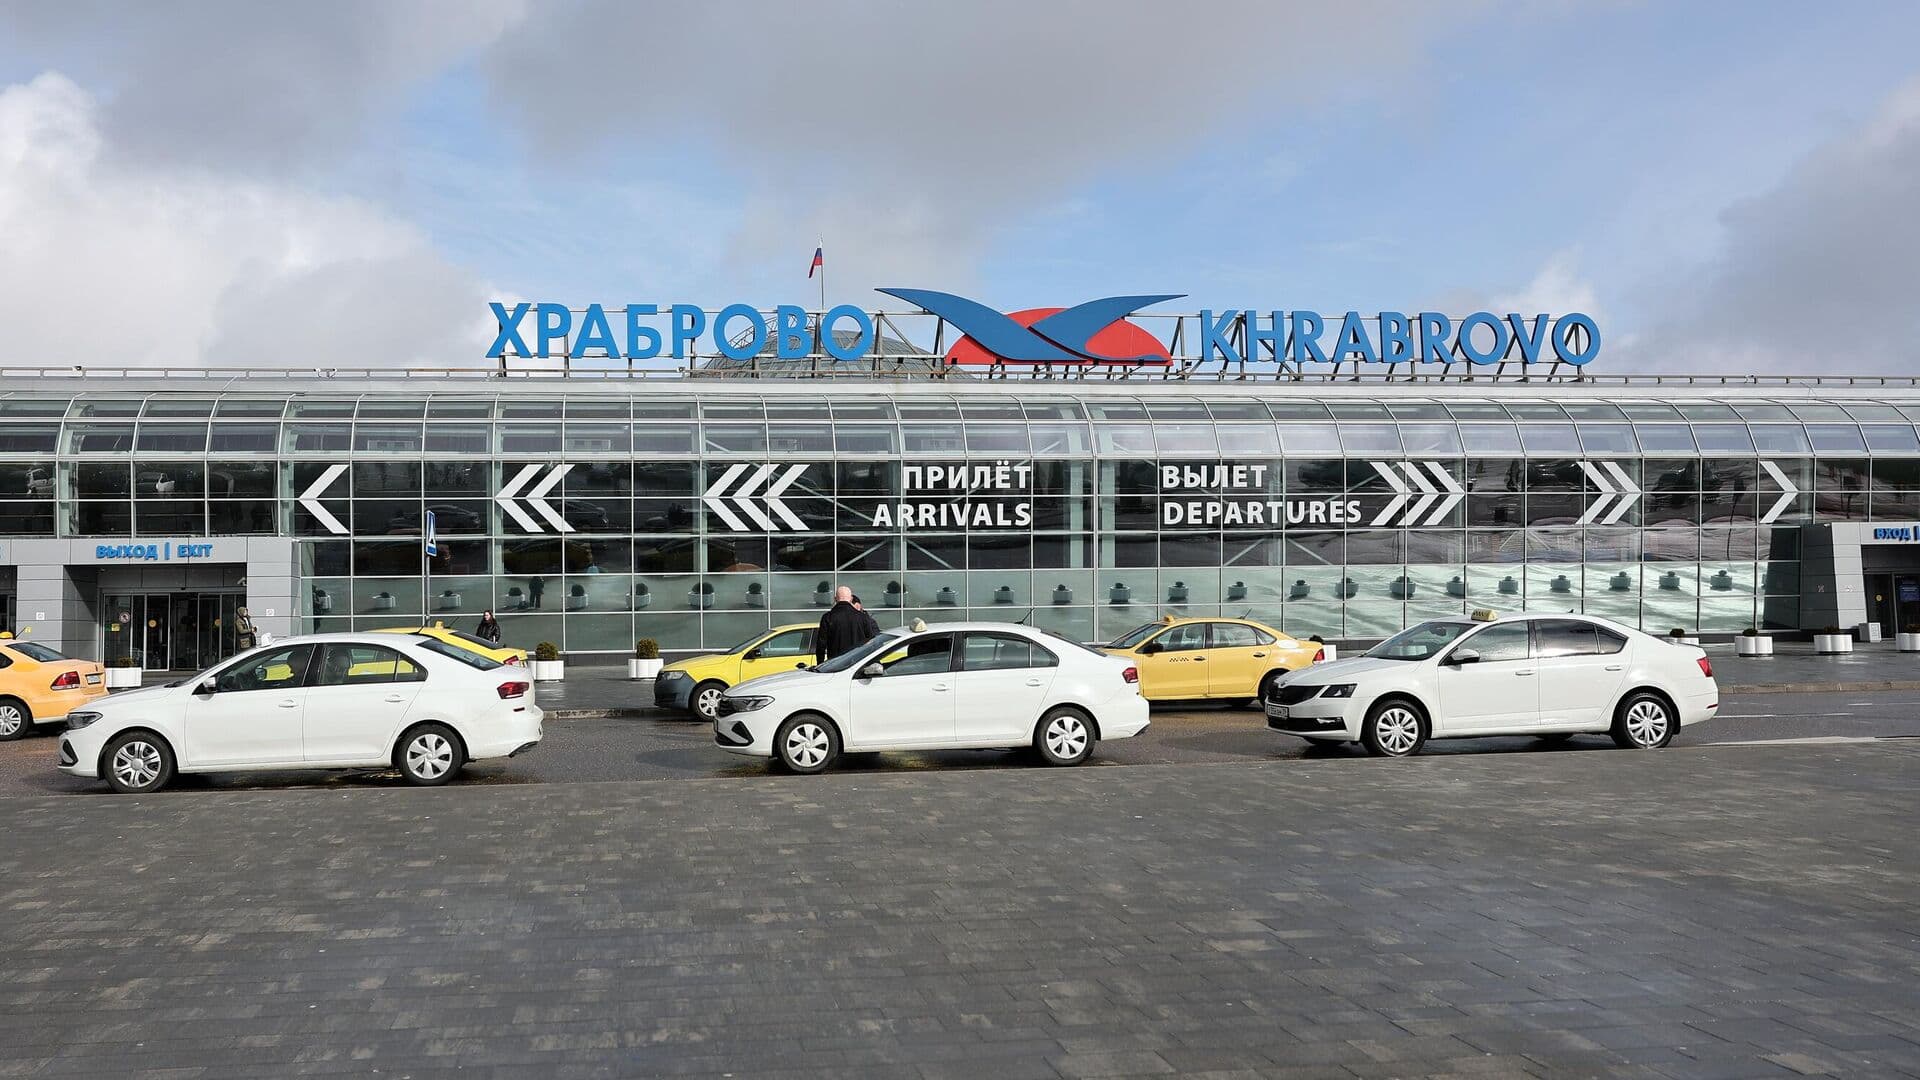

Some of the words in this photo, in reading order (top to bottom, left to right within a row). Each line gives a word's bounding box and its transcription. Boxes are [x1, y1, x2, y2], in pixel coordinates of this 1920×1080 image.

[486, 302, 873, 361] ХРАБРОВО
[1200, 309, 1601, 366] KHRABROVO
[903, 461, 1031, 489] ПРИЛЁТ
[1162, 465, 1267, 488] ВЫЛЕТ
[872, 503, 1031, 527] ARRIVALS
[1163, 500, 1362, 525] DEPARTURES
[1874, 528, 1911, 541] ВХОД
[96, 544, 159, 560] ВЫХОД
[177, 544, 213, 558] EXIT
